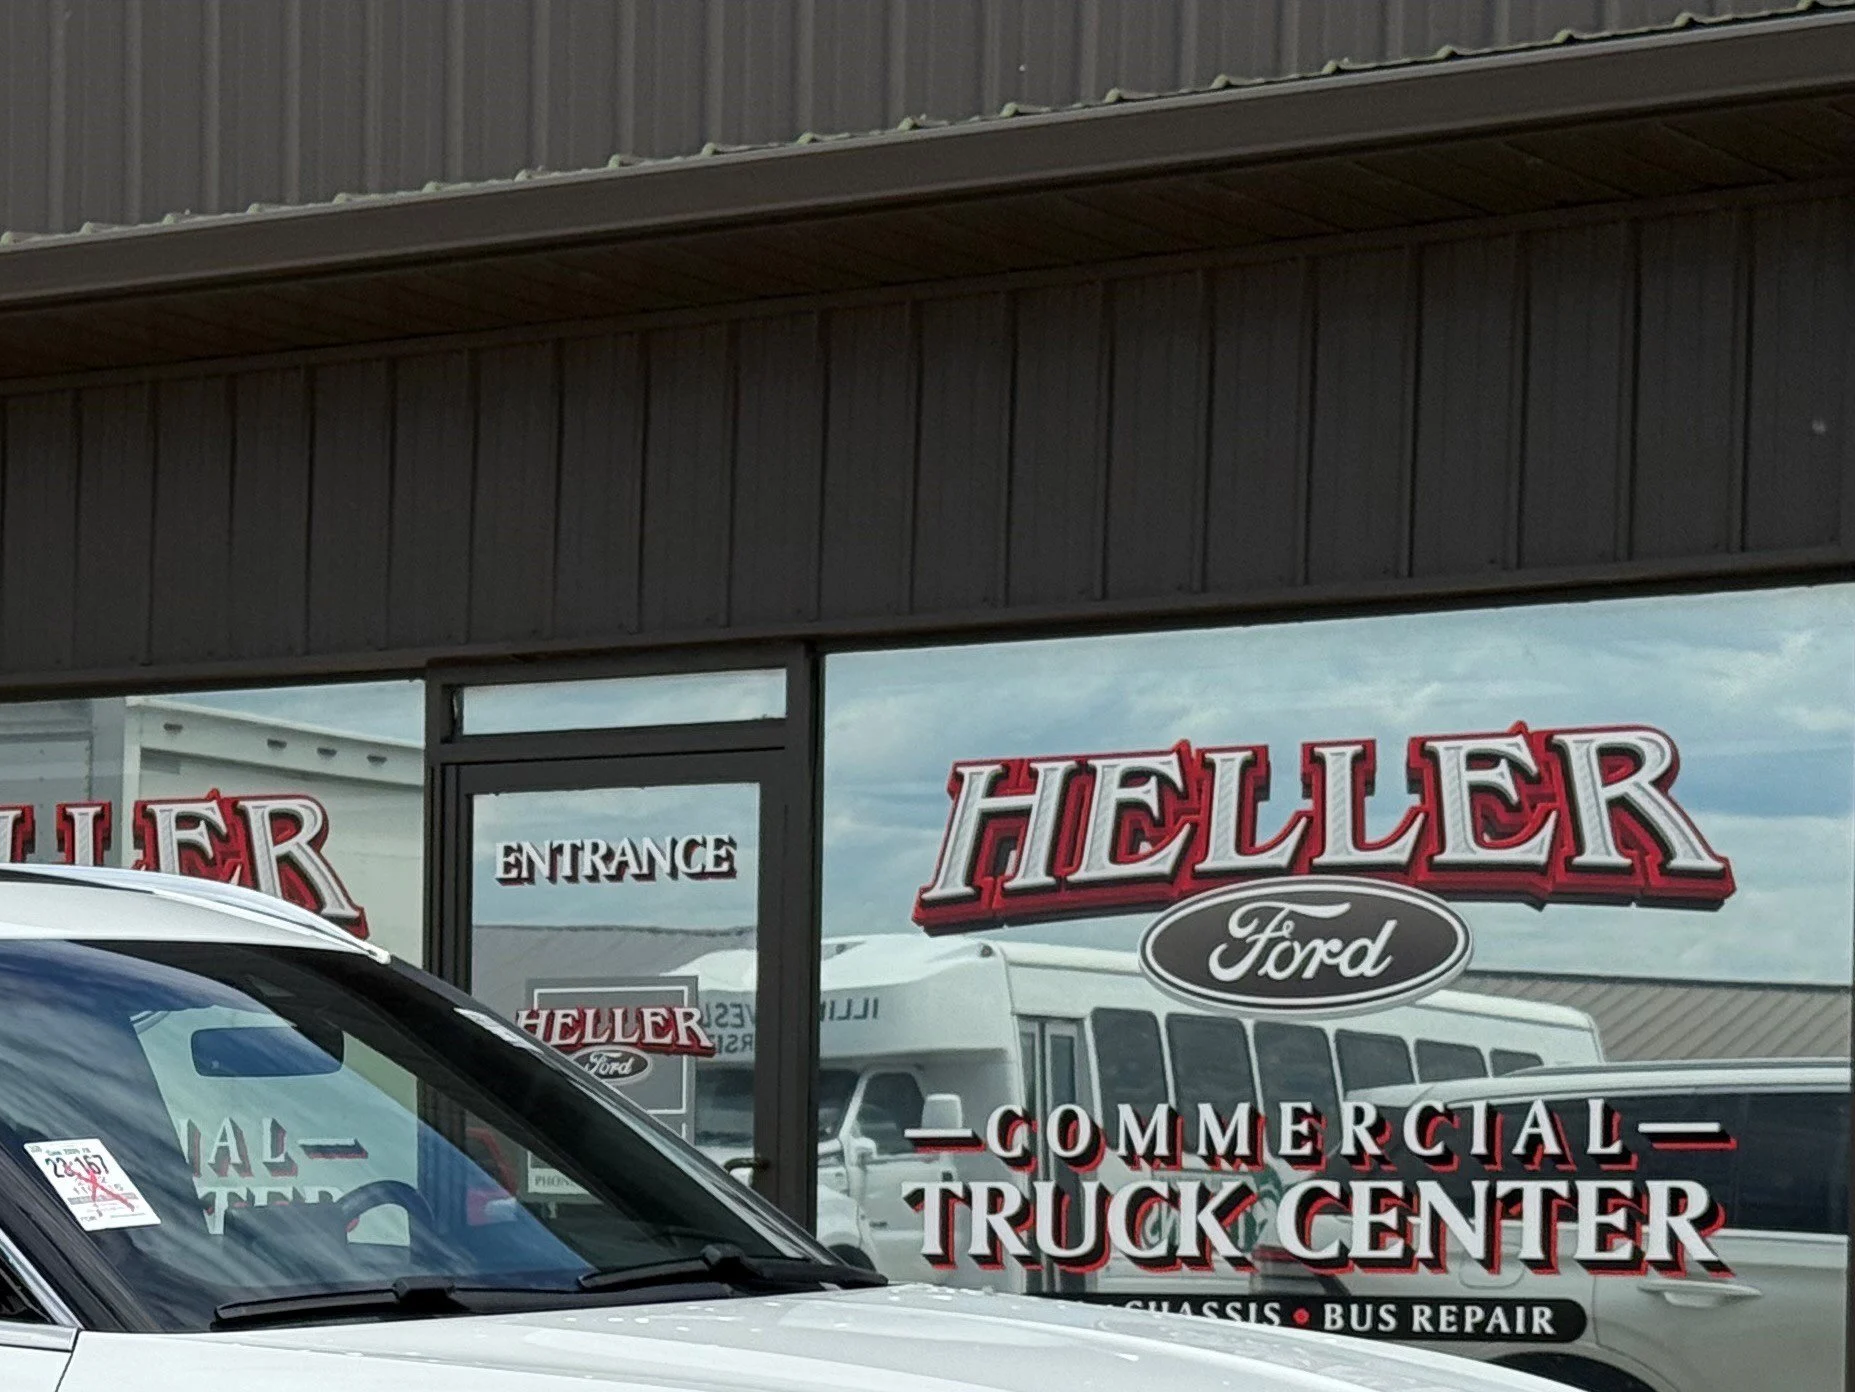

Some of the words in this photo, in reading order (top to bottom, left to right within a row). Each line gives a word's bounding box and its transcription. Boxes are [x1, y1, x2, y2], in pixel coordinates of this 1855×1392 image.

[916, 726, 1732, 915] HELLER
[495, 834, 735, 882] ENTRANCE
[1209, 901, 1397, 982] Ford
[584, 1051, 633, 1076] Ford
[986, 1099, 1629, 1162] COMMERCIAL
[902, 1180, 1257, 1265] TRUCK
[1277, 1179, 1726, 1268] CENTER
[1324, 1303, 1397, 1332] BUS
[1412, 1305, 1556, 1334] REPAIR
